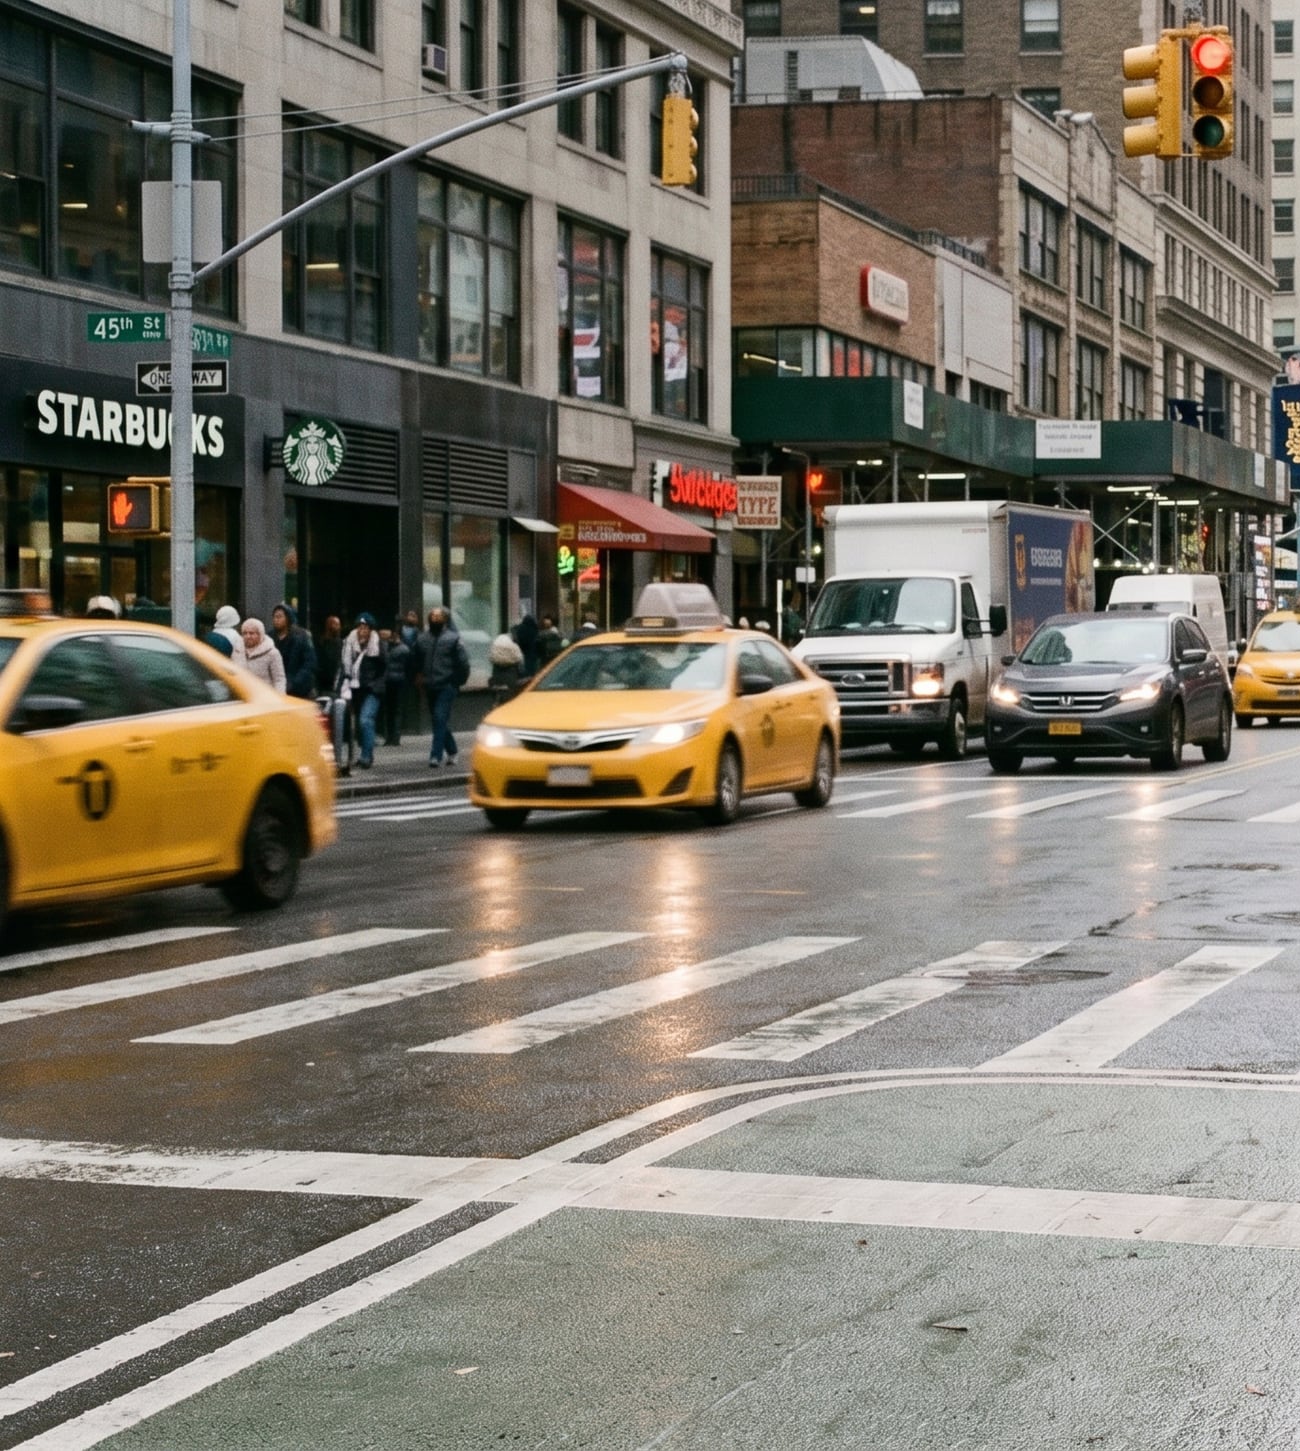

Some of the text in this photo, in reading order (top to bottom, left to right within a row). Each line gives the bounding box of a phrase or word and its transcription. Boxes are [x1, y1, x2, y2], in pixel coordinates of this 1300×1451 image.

[94, 316, 160, 339] 45th St
[150, 371, 216, 385] ONE WAY
[38, 389, 225, 457] STARBUKS
